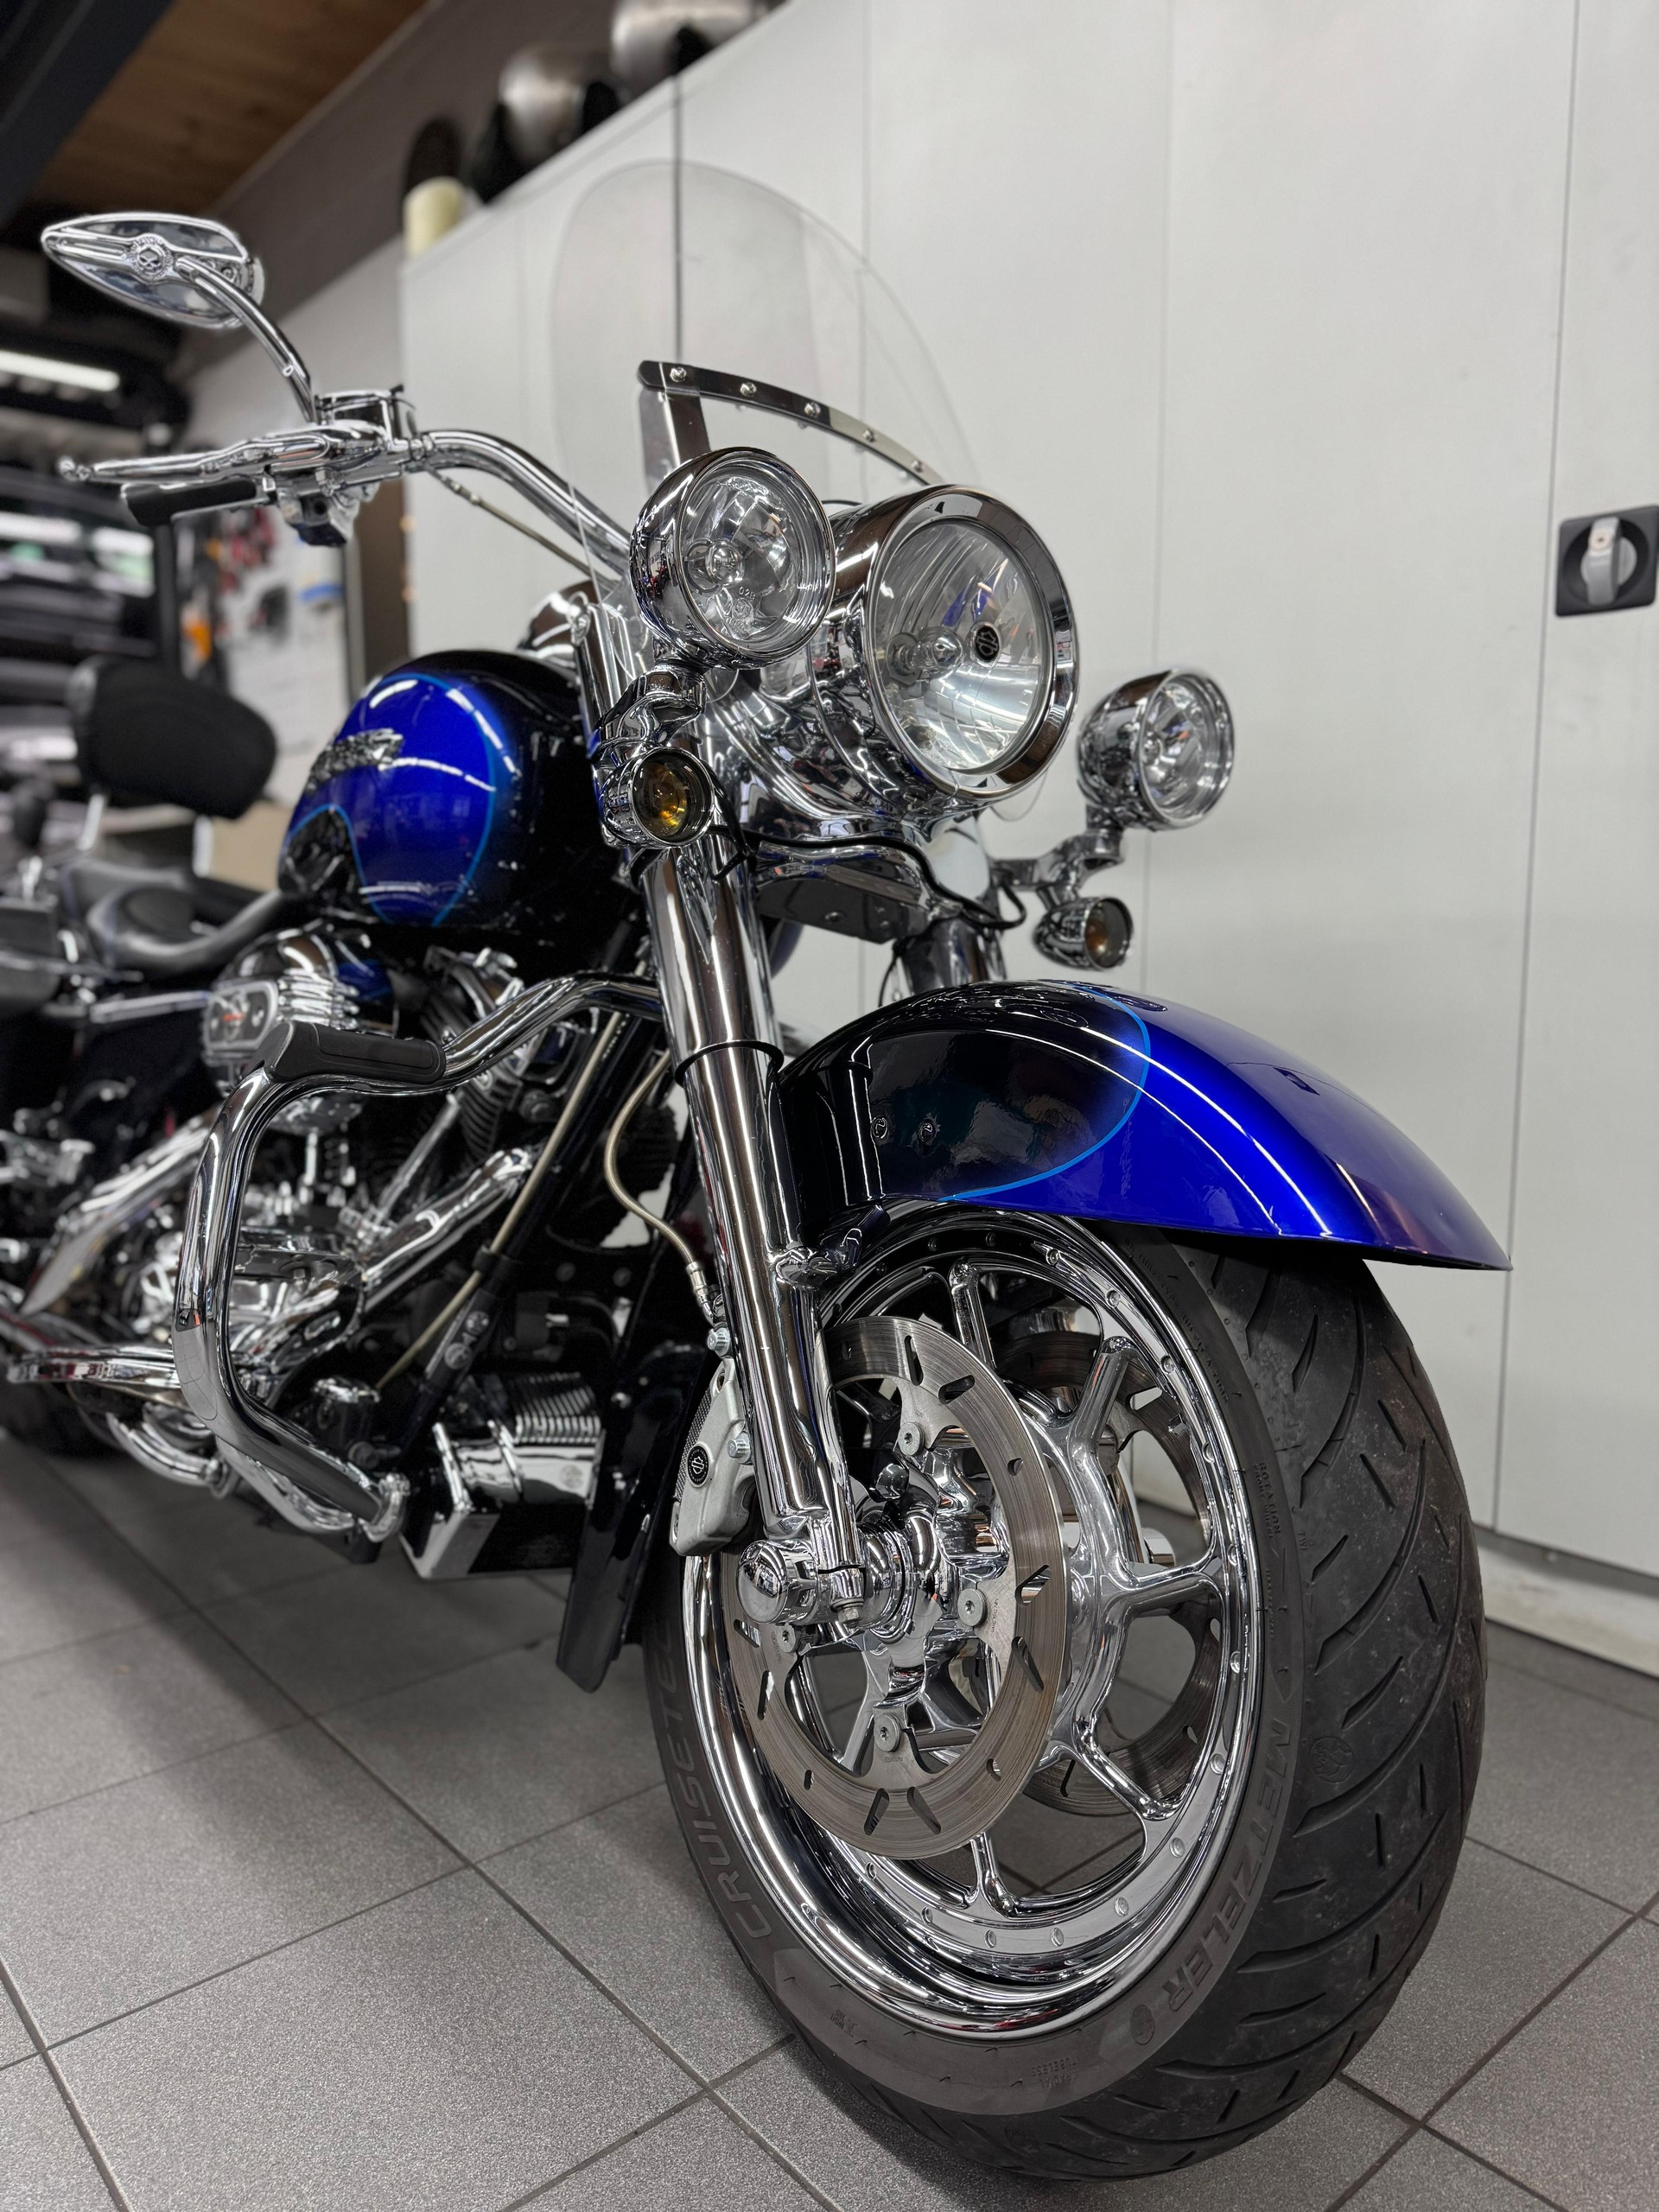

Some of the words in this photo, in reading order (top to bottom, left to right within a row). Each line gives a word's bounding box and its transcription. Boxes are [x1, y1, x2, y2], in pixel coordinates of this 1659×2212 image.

[1259, 1461, 1281, 1535] ROTATION
[652, 1614, 772, 1938] CRUISETEC
[1162, 1718, 1292, 2012] METZELER
[1031, 2057, 1078, 2077] TUBELESS
